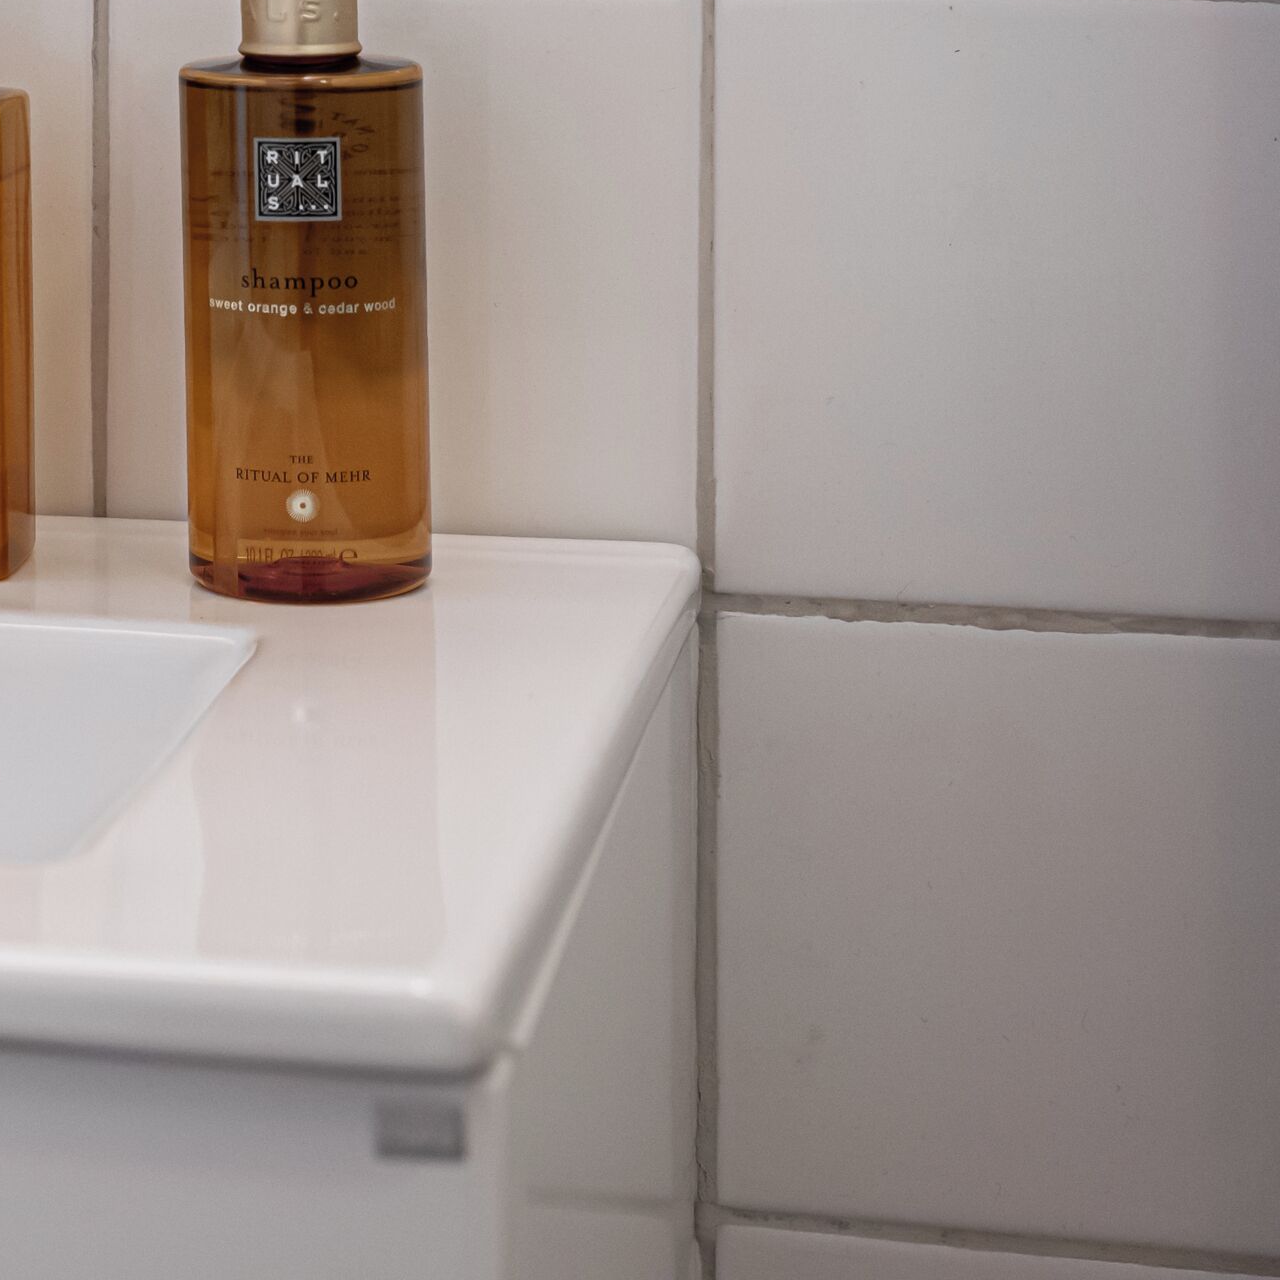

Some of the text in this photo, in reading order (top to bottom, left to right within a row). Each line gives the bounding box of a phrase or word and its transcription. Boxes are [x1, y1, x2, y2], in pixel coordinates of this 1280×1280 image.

[241, 268, 358, 298] shampoo
[209, 297, 396, 317] sweet orange & cedar wood
[289, 455, 314, 465] THE
[236, 468, 371, 484] RITUAL OF MEHR
